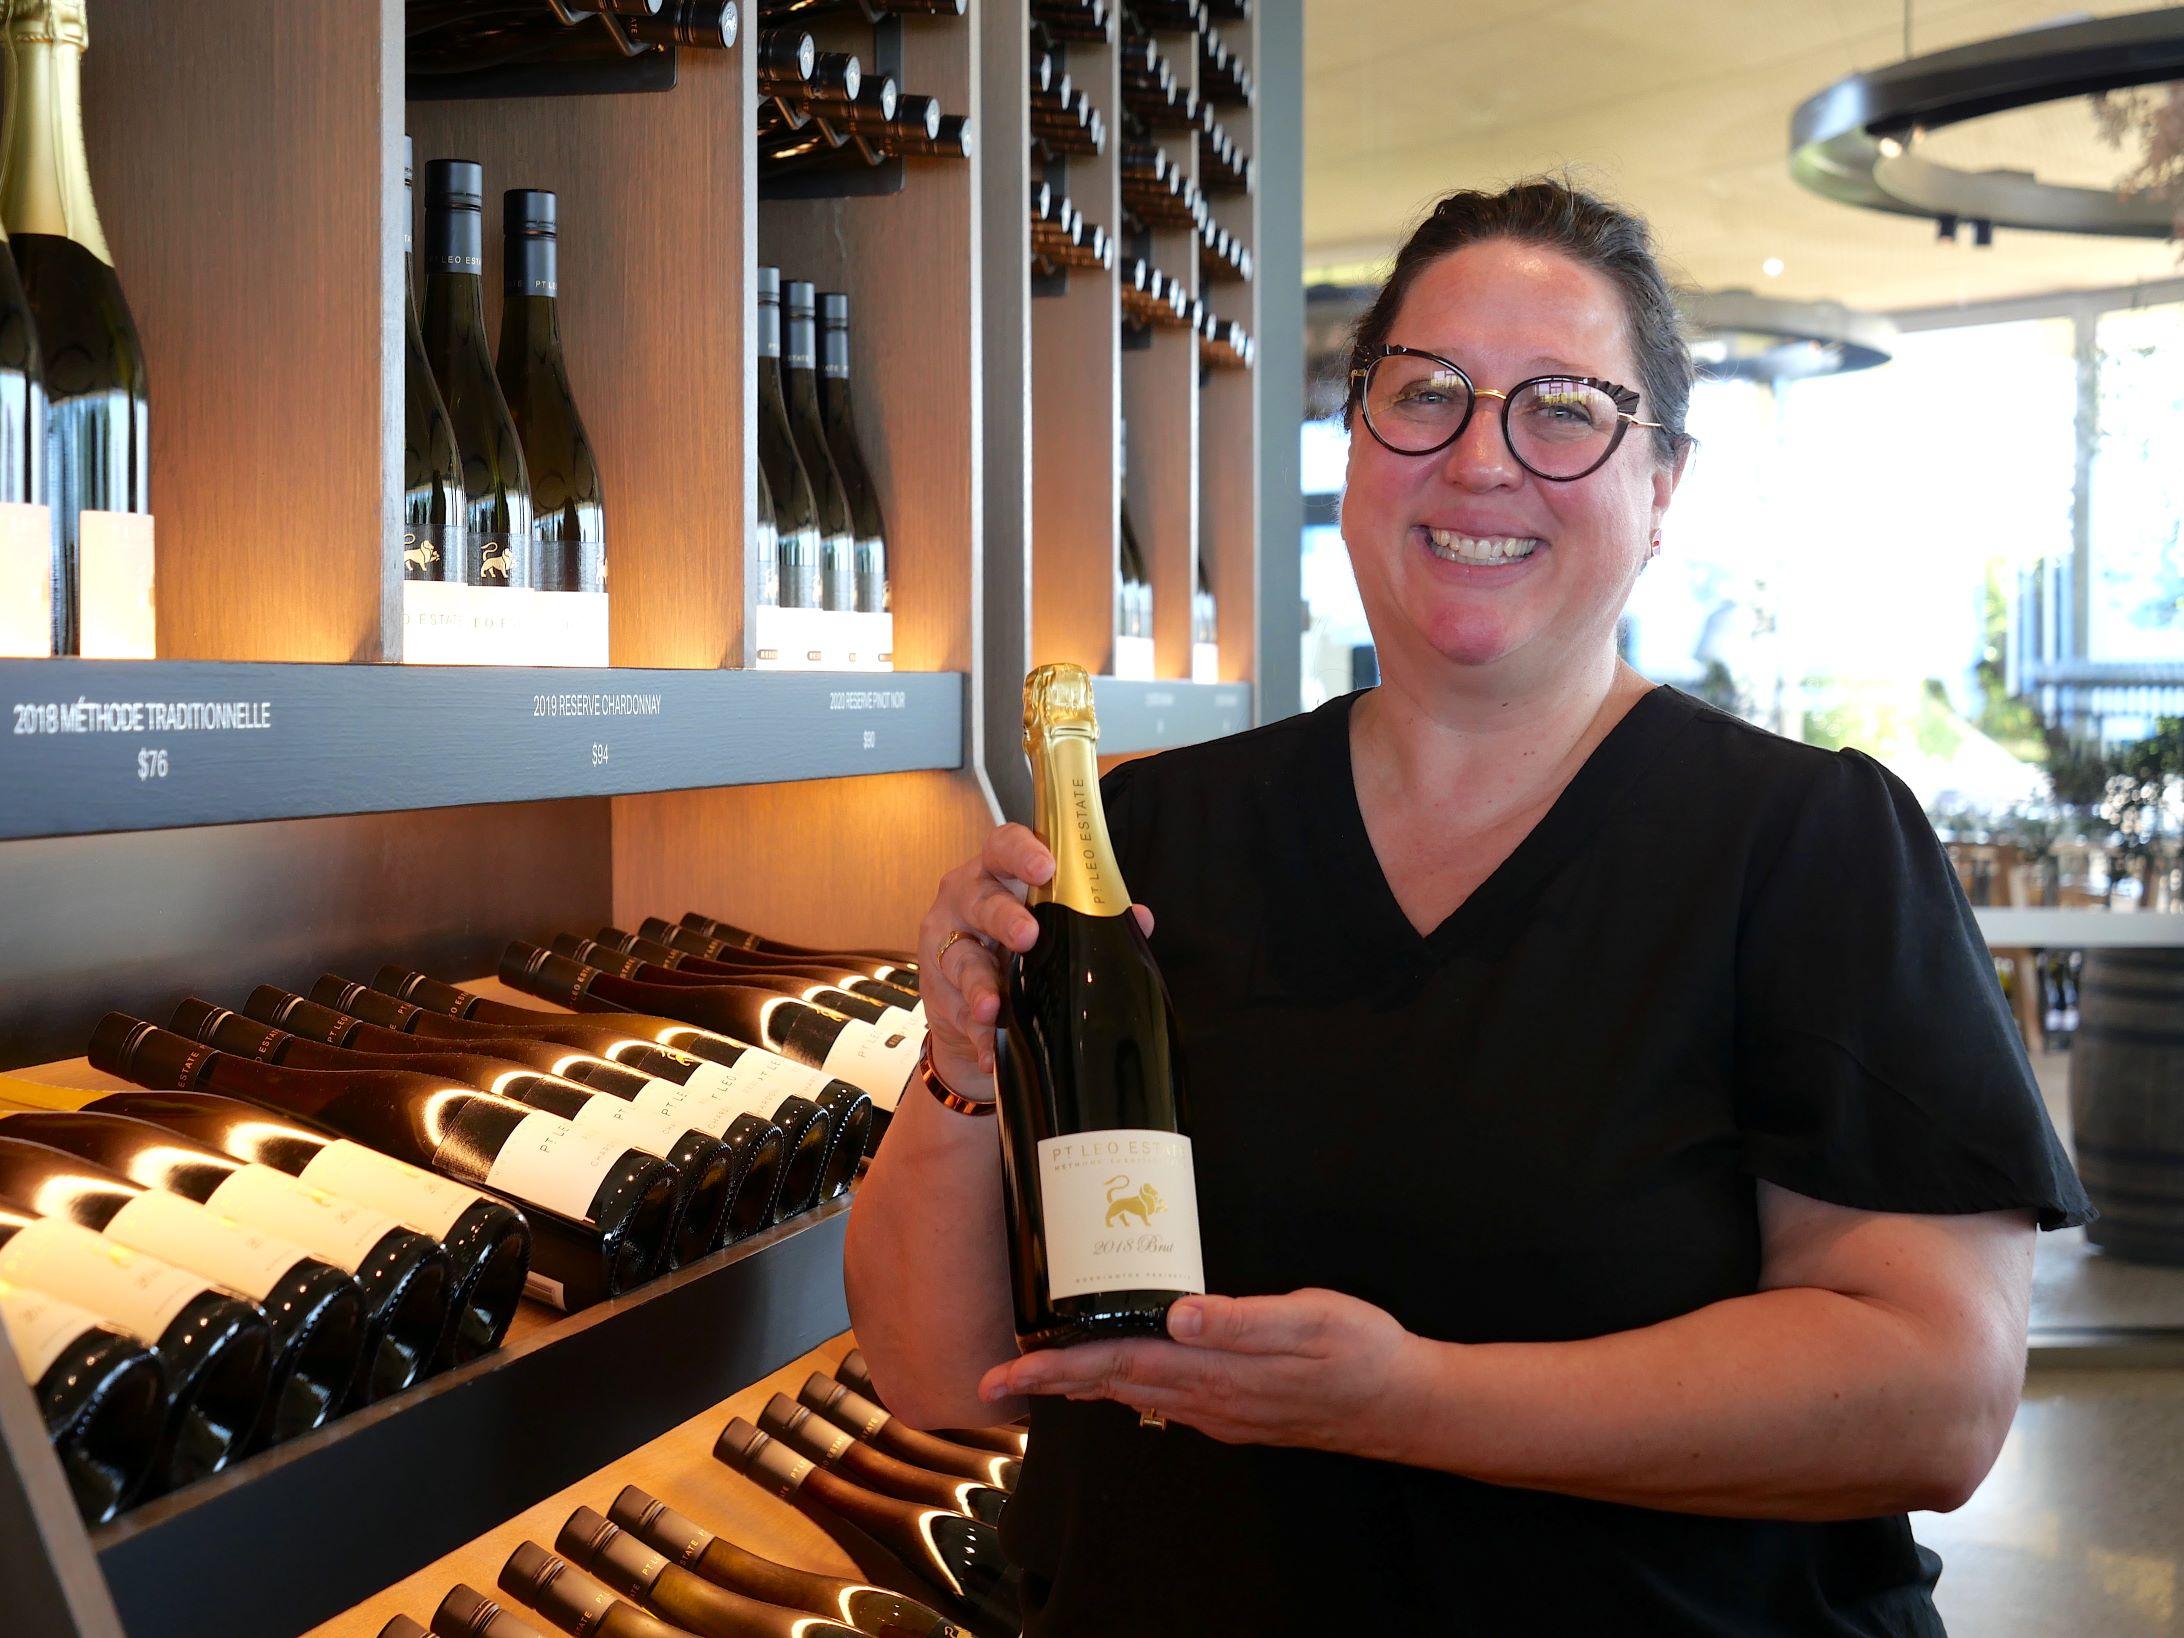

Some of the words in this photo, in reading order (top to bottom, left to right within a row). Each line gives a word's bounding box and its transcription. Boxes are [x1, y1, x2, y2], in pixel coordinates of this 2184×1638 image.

[13, 703, 59, 735] 2018
[60, 695, 145, 733] MÉTHODE
[147, 701, 272, 731] TRADITIONNELLE
[533, 694, 558, 717] 2019
[559, 694, 601, 716] RESERVE
[602, 693, 662, 716] CHARDONNAY
[137, 748, 169, 782] $76
[591, 741, 609, 768] $94
[1072, 778, 1092, 842] ESTATE
[1083, 849, 1100, 881] LEO
[178, 1050, 201, 1088] ESTATE
[1081, 1141, 1120, 1157] LEO
[1093, 1239, 1134, 1255] 2018
[1136, 1233, 1176, 1253] Brut
